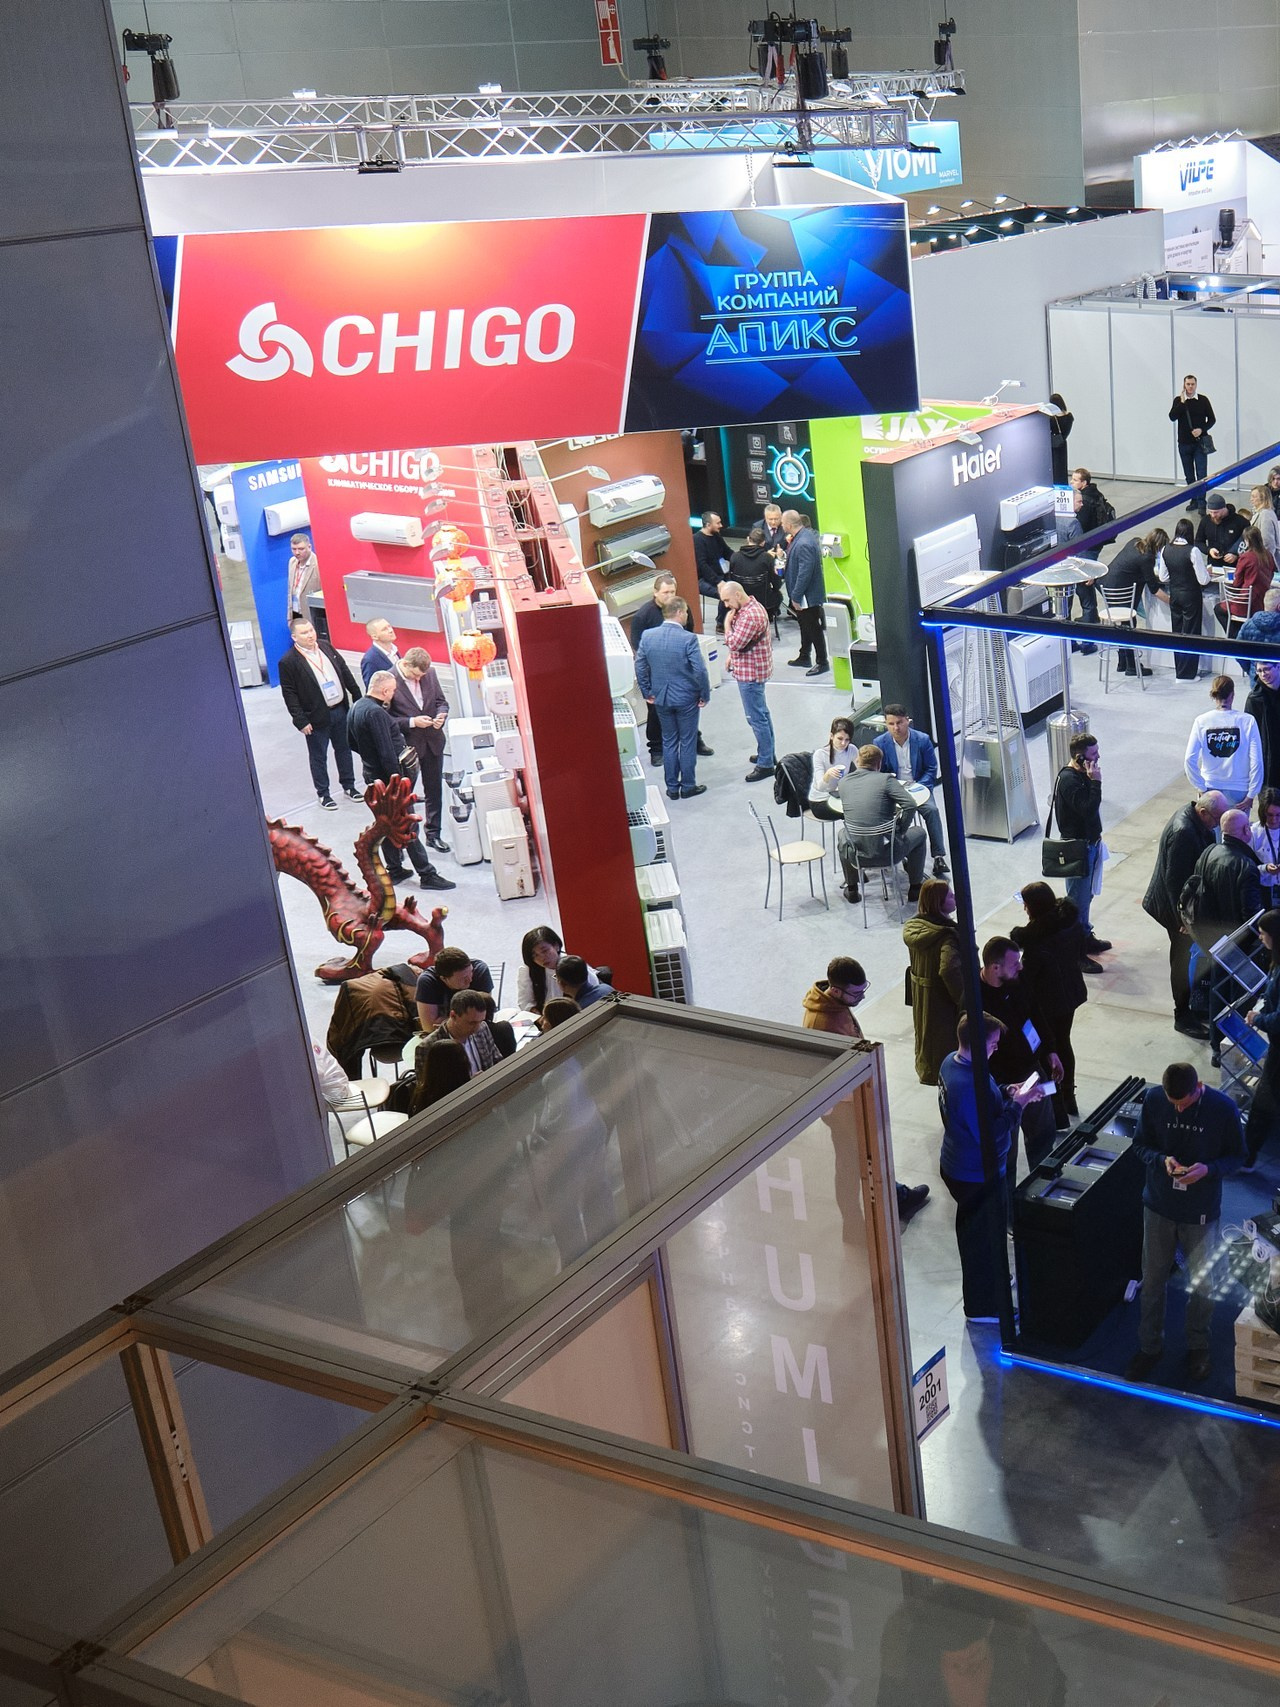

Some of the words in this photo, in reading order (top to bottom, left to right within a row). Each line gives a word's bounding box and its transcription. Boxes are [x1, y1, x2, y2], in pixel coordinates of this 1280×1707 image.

[1179, 158, 1215, 191] VILPE
[734, 271, 818, 290] ГРУППА
[717, 285, 839, 311] КОМПАНИЙ
[322, 303, 576, 377] CHIGO
[706, 316, 859, 356] АПИКС
[248, 462, 301, 491] SAMSU
[952, 443, 1002, 487] Haier
[1207, 731, 1238, 744] Future
[1167, 1122, 1204, 1133] TURKOV
[918, 1378, 942, 1411] 2001
[924, 1371, 934, 1389] D
